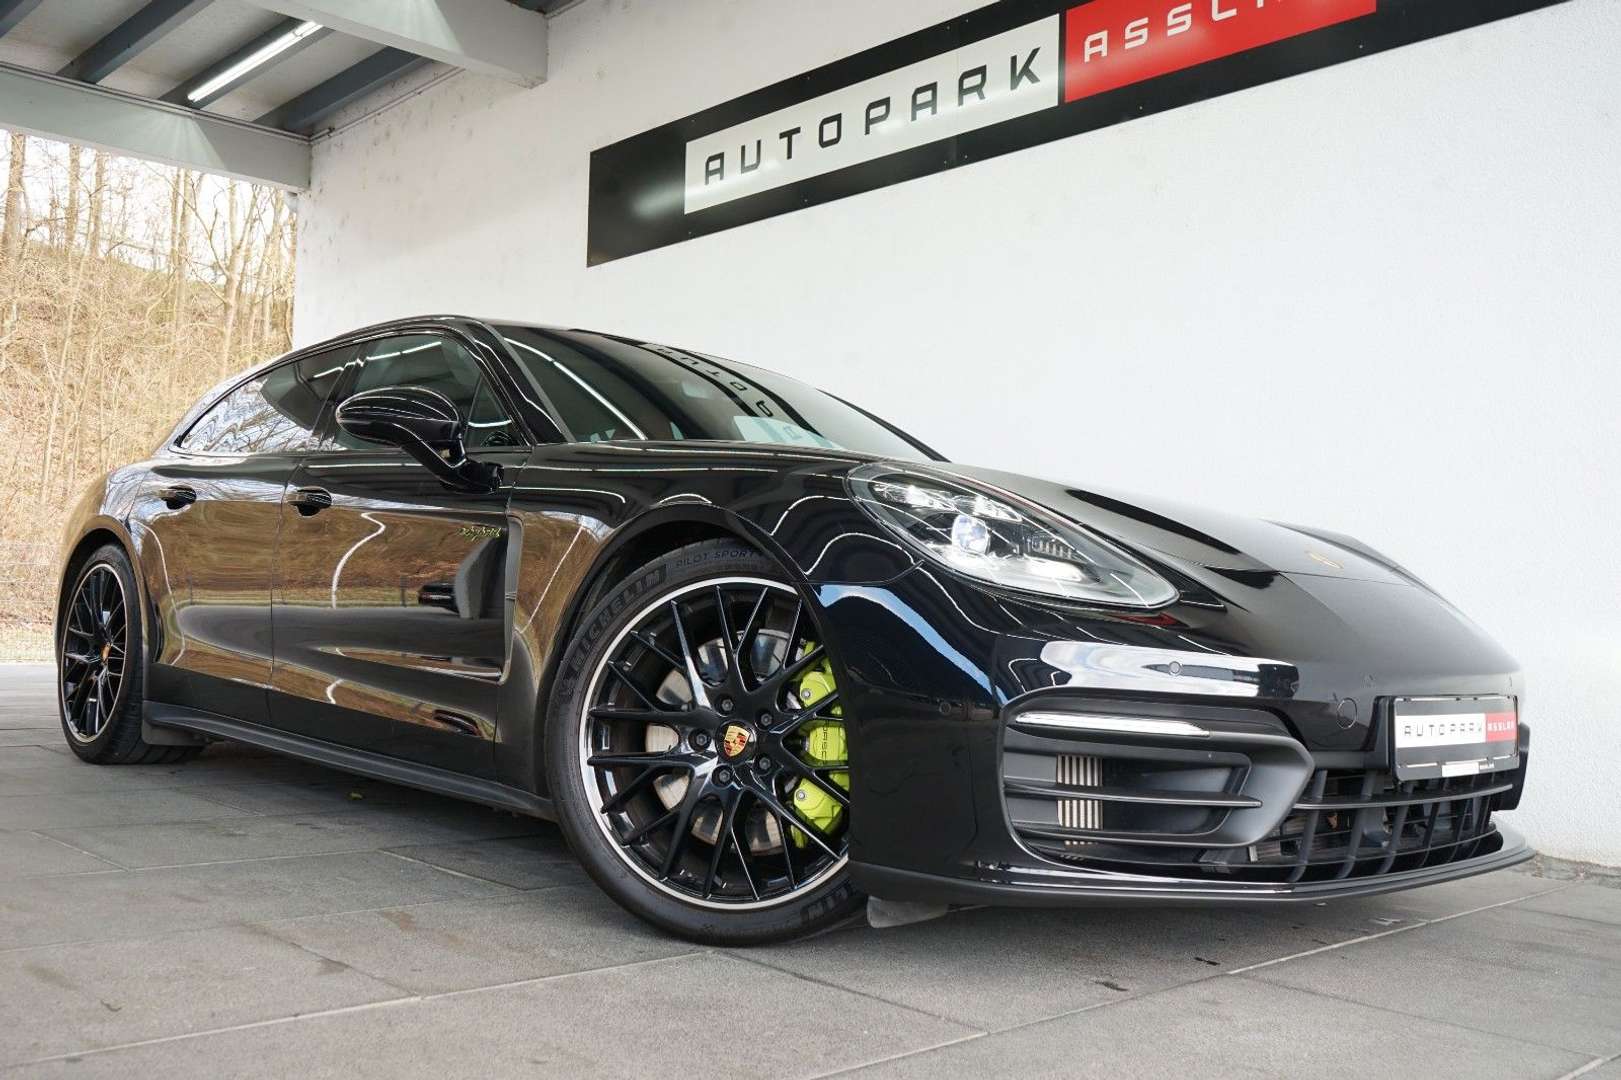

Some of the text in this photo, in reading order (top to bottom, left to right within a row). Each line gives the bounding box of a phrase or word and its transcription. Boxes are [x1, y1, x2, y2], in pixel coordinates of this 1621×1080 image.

[703, 0, 1265, 186] AUTOPARK ASSL
[676, 551, 710, 567] PILOT
[713, 549, 756, 560] SPORT
[570, 568, 662, 672] MICHELIN
[821, 719, 829, 764] ORSC
